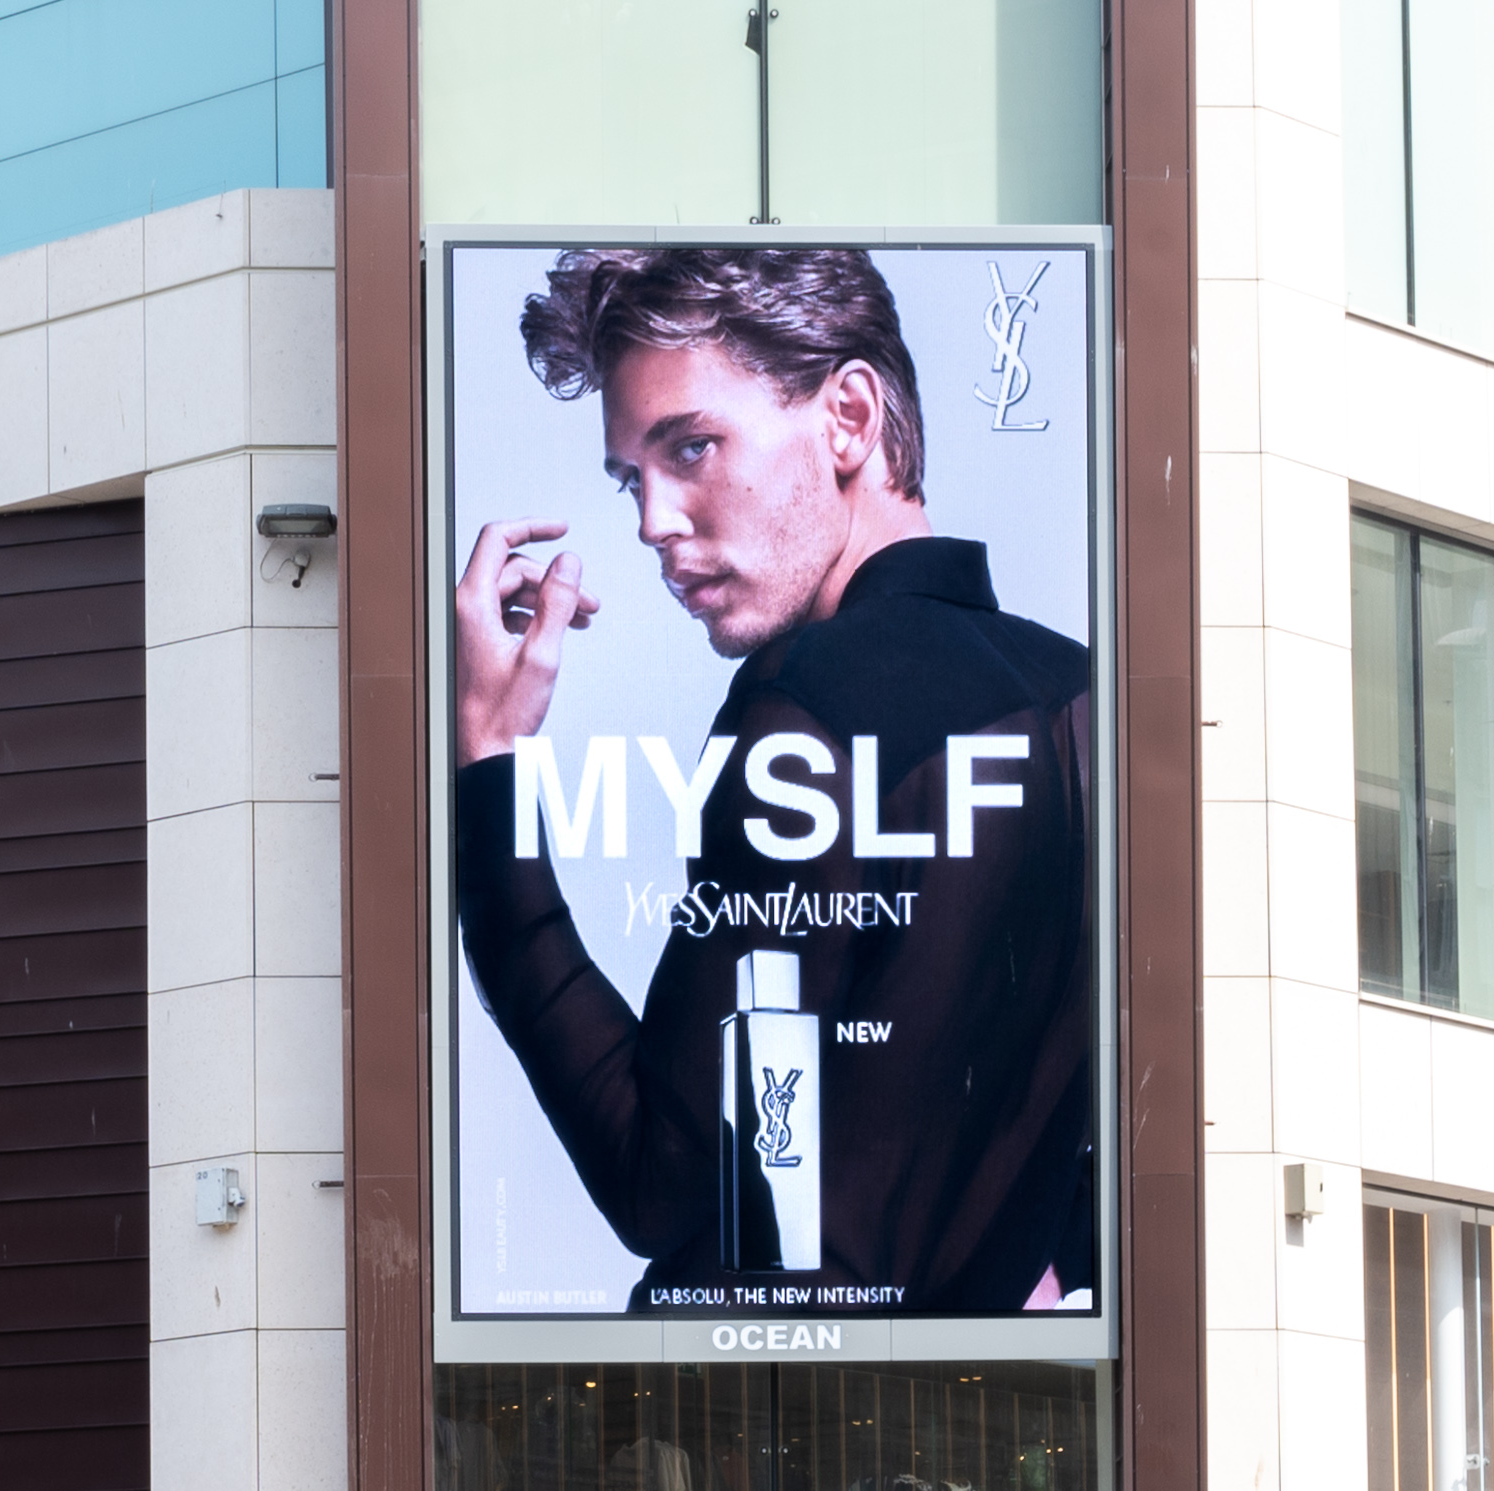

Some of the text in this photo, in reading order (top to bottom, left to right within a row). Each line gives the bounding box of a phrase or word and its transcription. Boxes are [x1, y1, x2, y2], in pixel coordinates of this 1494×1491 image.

[514, 733, 1031, 860] MYSLF
[836, 1021, 892, 1043] NEW
[496, 1290, 607, 1305] AUSTIN BUTLER
[734, 1287, 767, 1305] THE
[773, 1287, 811, 1304] NEW
[817, 1286, 905, 1304] INTENSITY
[712, 1325, 841, 1351] OCEAN
